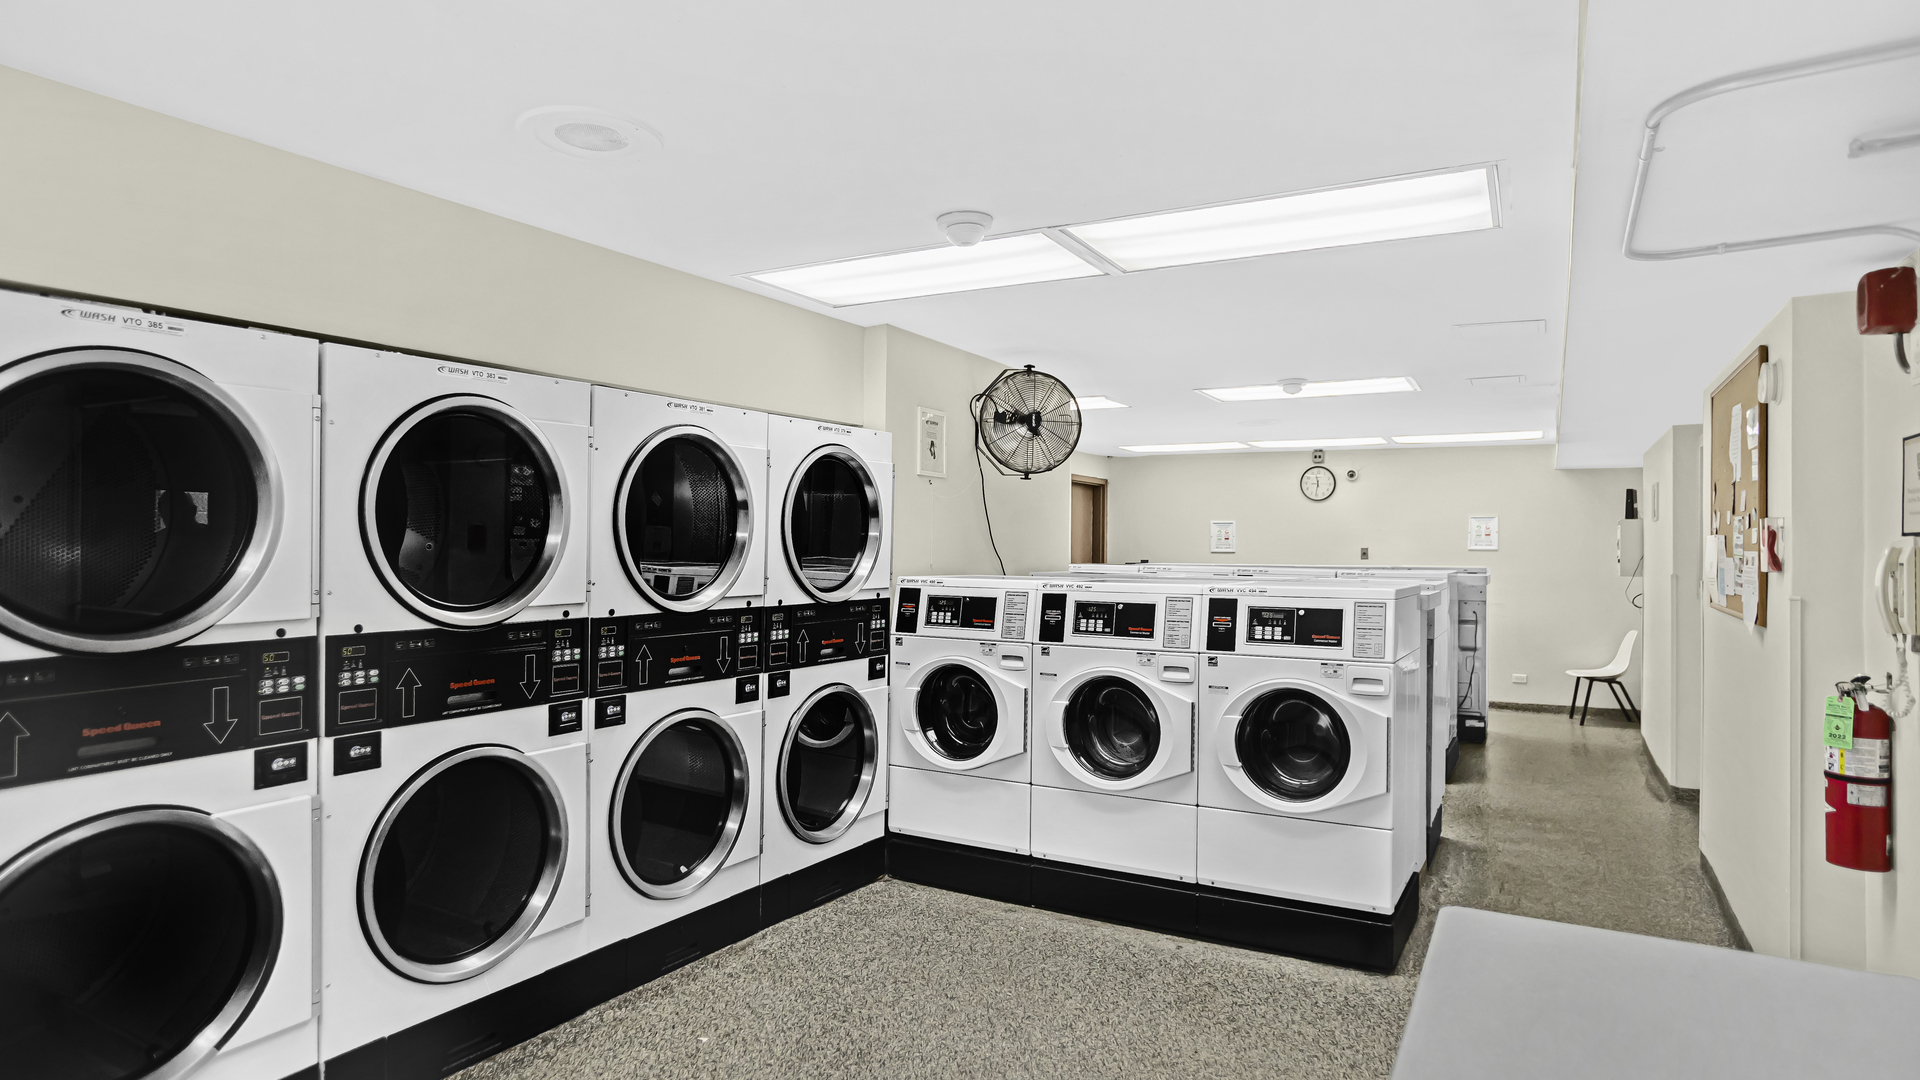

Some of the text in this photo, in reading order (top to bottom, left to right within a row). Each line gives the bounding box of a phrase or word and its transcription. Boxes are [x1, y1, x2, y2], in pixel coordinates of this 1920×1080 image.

[80, 310, 163, 329] WASH VTO 385
[448, 367, 469, 375] WASH
[342, 648, 352, 656] 50
[450, 680, 472, 689] Speed
[82, 720, 161, 737] Speed Queen
